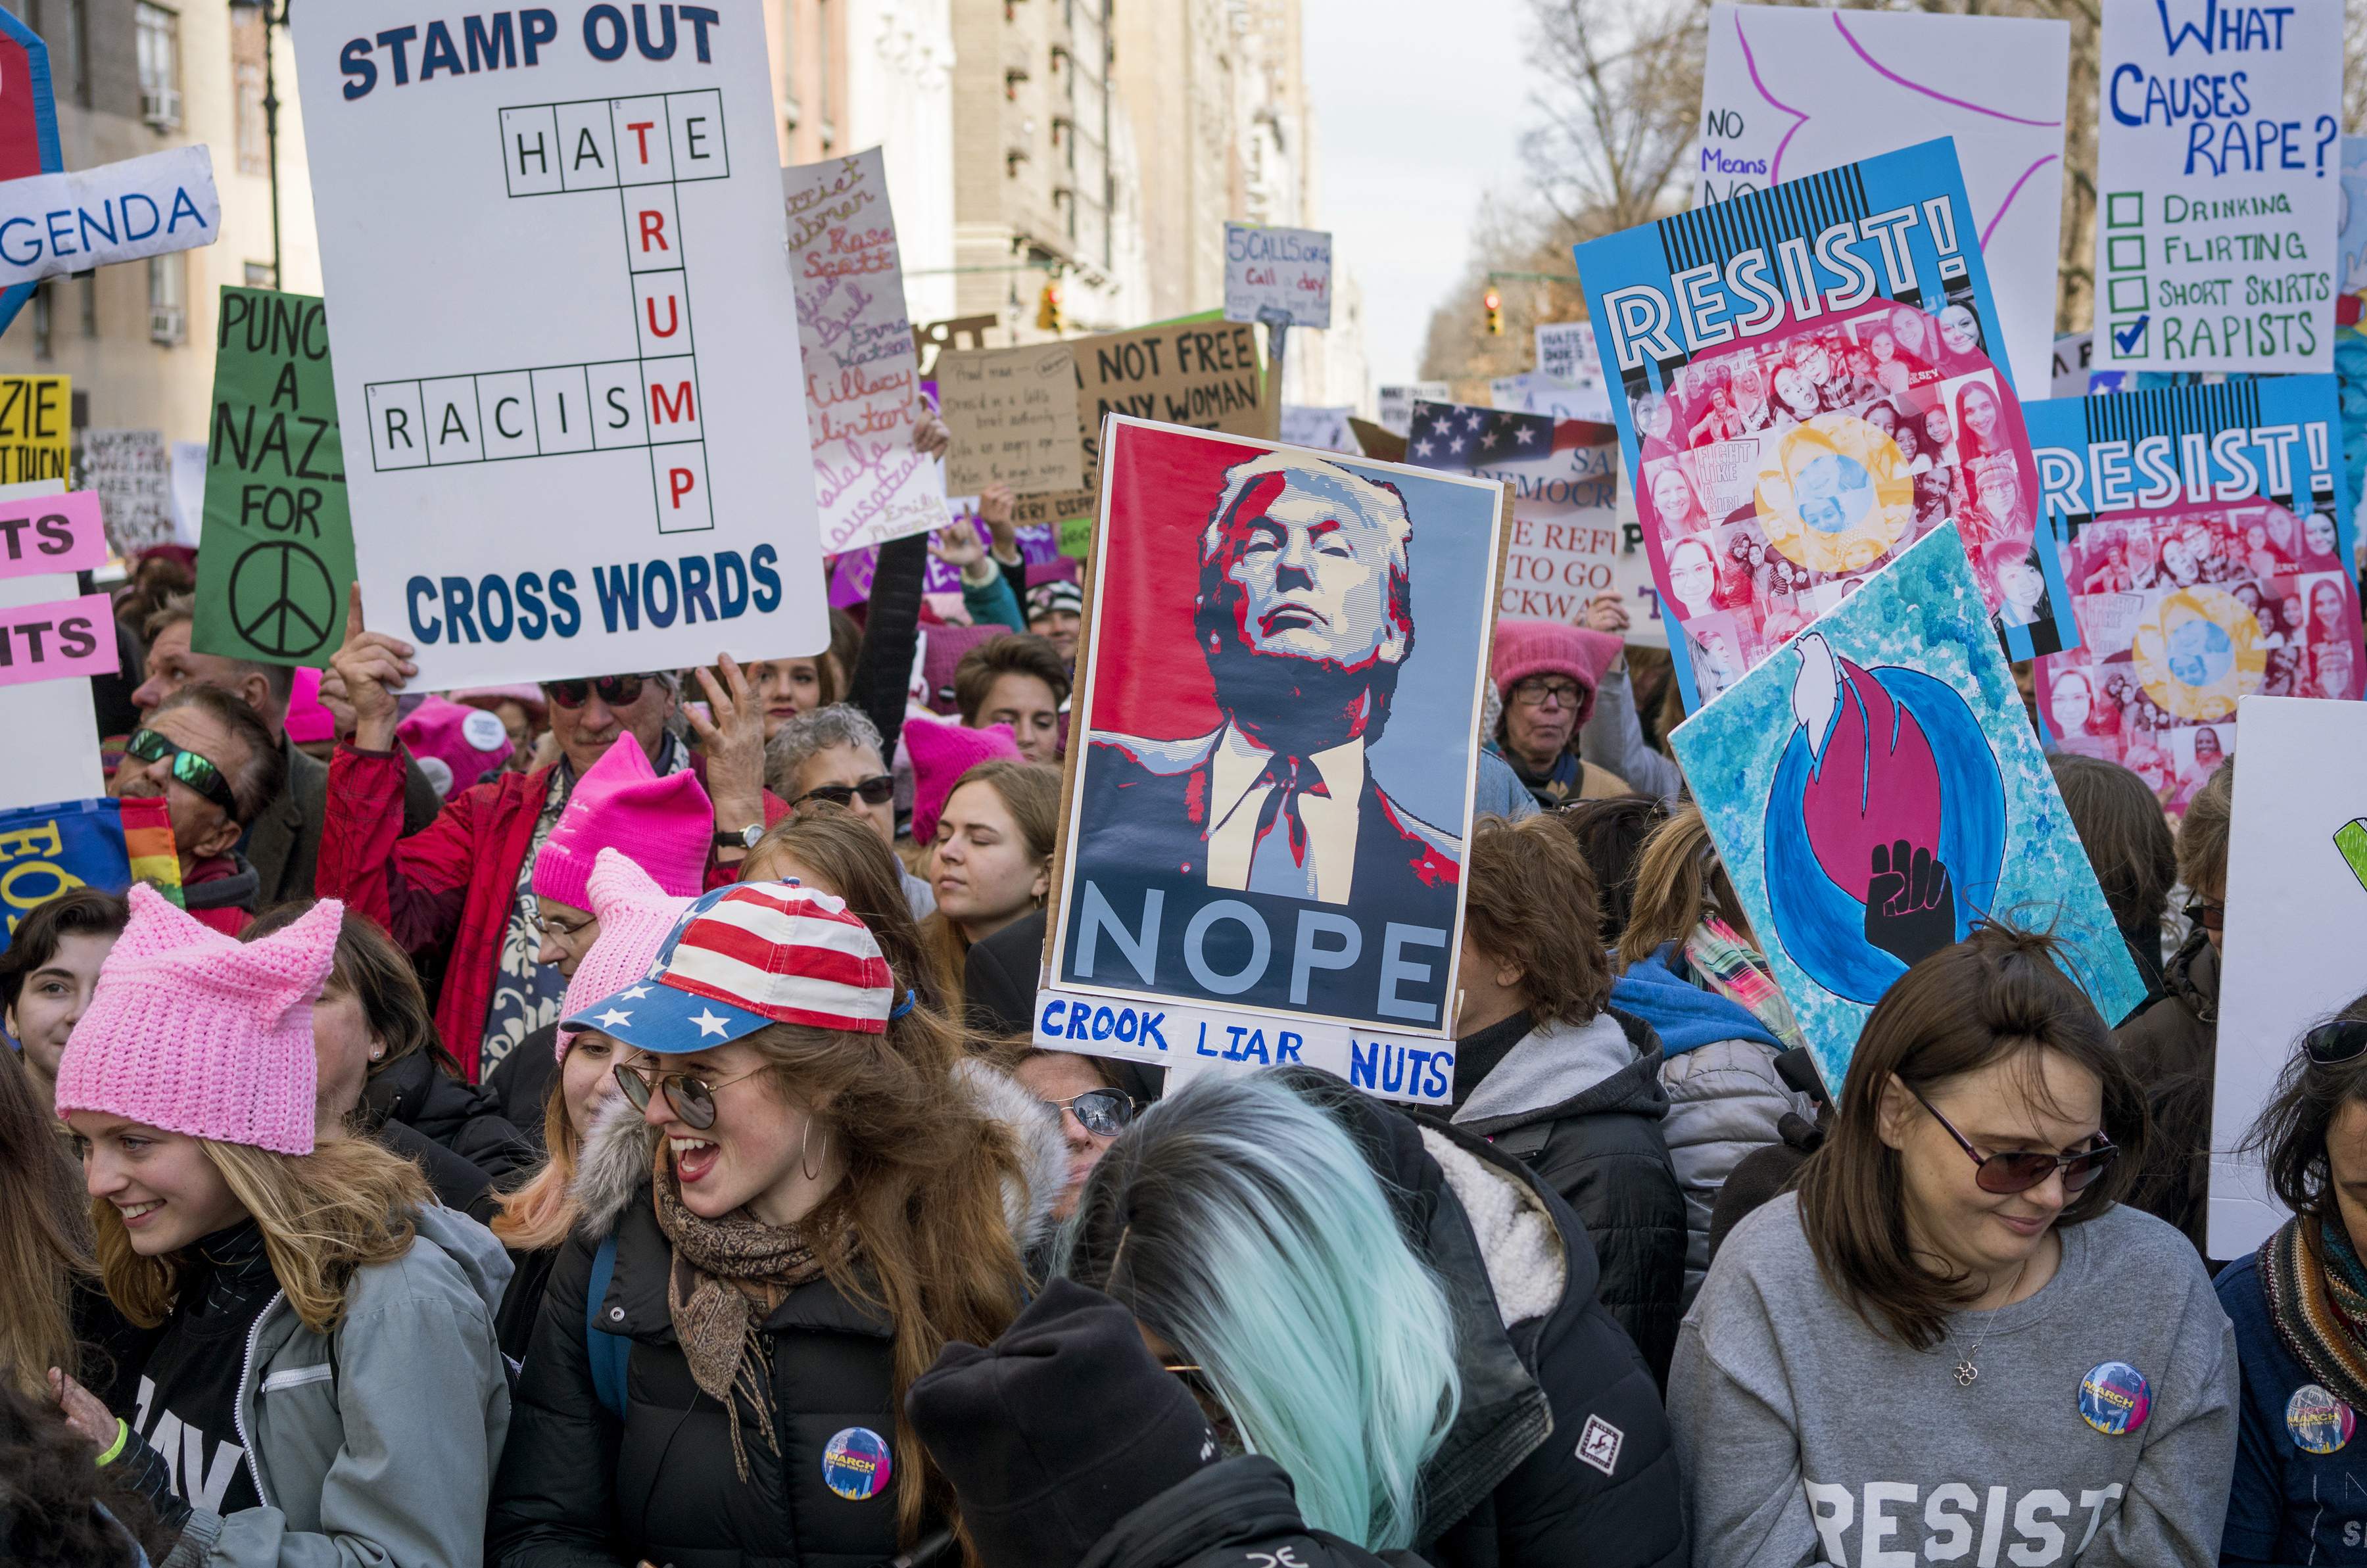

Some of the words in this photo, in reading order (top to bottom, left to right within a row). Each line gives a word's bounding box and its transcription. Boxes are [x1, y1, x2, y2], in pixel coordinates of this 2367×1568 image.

[339, 8, 558, 101] STAMP
[583, 3, 719, 64] OUT
[2156, 0, 2295, 57] WHAT
[2110, 62, 2251, 127] CAUSES
[516, 116, 710, 176] HATE
[1707, 108, 1744, 139] NO
[2184, 114, 2337, 178] RAPE?
[1701, 147, 1767, 175] Means
[0, 186, 208, 267] GENDA
[2164, 193, 2292, 224] DRINKING
[2164, 232, 2307, 264] FLIRTING
[1602, 195, 1967, 371] RESIST!
[2159, 279, 2232, 308] SHORT
[2245, 272, 2330, 306] SKIRTS
[1097, 337, 1162, 384] NOT
[1176, 327, 1253, 374] FREE
[2163, 311, 2316, 360] RAPISTS
[270, 362, 299, 412] A
[1164, 375, 1257, 422] WOMAN
[384, 380, 696, 450] RACISM
[1571, 446, 1617, 477] SA
[1696, 442, 1751, 466] FIGHT
[1699, 463, 1738, 485] LIKE
[2031, 421, 2333, 516] RESIST!
[241, 484, 323, 539] FOR
[406, 569, 581, 645] CROSS
[592, 543, 782, 634] WORDS
[1509, 554, 1554, 583] TO
[1564, 561, 1612, 590] GO
[1074, 880, 1447, 1022] NOPE
[1040, 999, 1168, 1051] CROOK
[1196, 1021, 1304, 1066] LIAR
[1349, 1039, 1454, 1098] NUTS
[2084, 1380, 2134, 1409] MARCH
[825, 1451, 876, 1471] MARCH
[1804, 1477, 2124, 1568] RESIST
